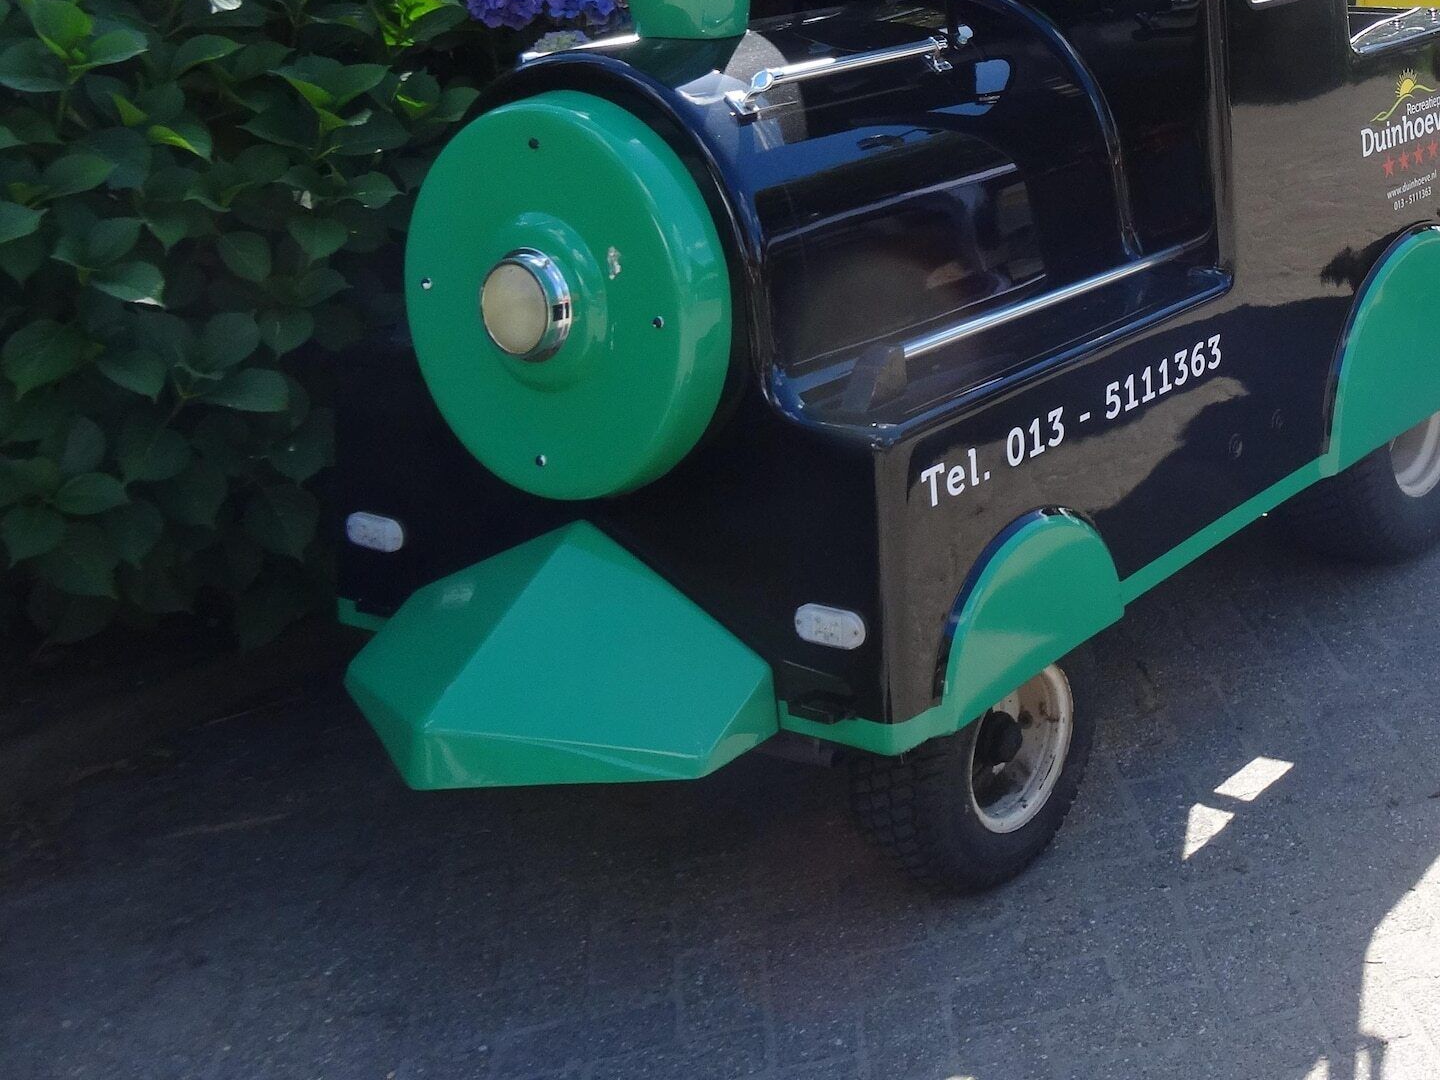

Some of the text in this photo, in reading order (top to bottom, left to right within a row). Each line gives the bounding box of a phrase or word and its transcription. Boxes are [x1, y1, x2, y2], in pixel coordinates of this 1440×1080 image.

[1387, 169, 1438, 199] www.duinhoeve.nl
[1393, 198, 1405, 211] 013
[1408, 186, 1432, 204] 5111363
[921, 447, 991, 508] Tel.
[1006, 405, 1066, 469] 013
[1105, 333, 1222, 420] 5111363
